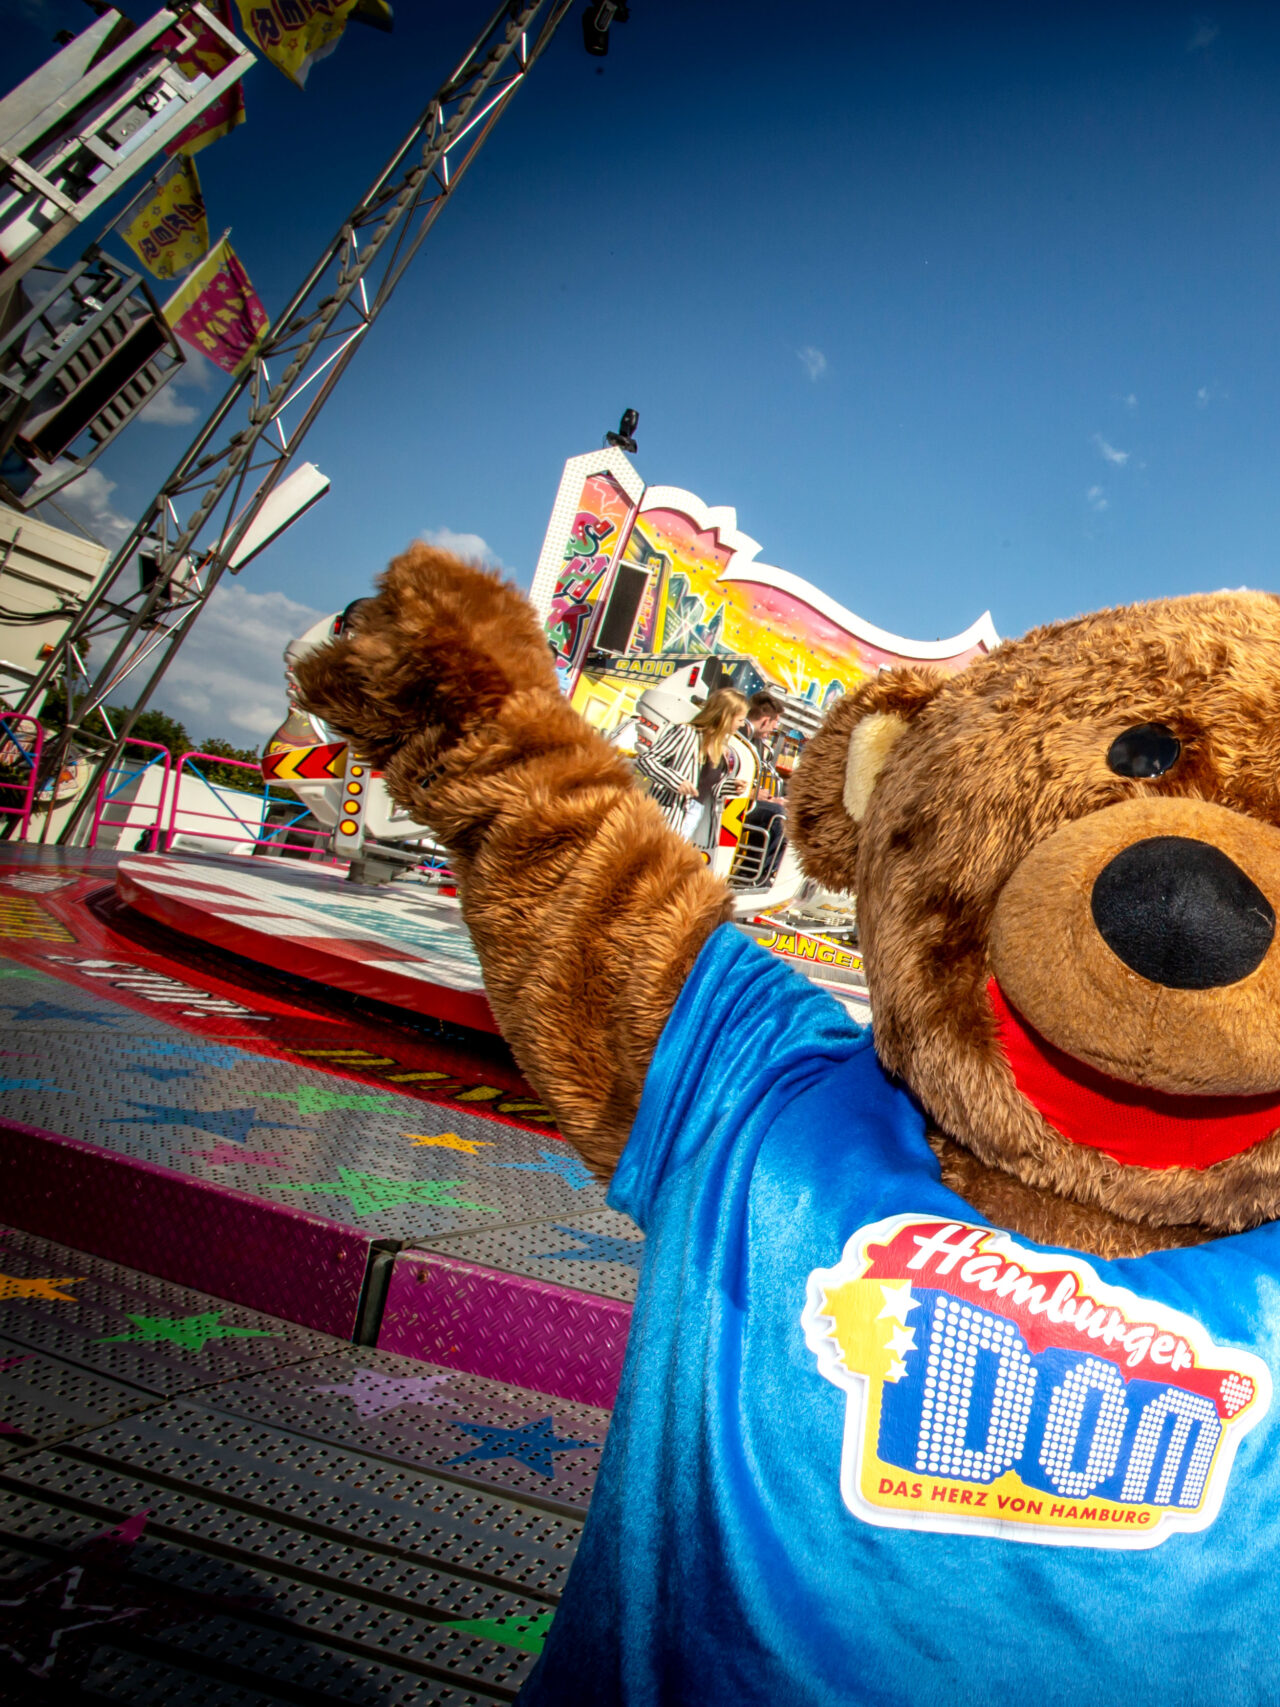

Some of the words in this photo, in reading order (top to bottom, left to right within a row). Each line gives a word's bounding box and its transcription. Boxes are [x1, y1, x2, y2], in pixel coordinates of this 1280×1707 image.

[615, 659, 676, 677] RADIO
[906, 1224, 1192, 1372] Hamburger
[878, 1478, 923, 1498] DAS
[931, 1485, 987, 1507] HERZ
[997, 1495, 1043, 1515] VON
[1050, 1504, 1152, 1525] HAMBURG
